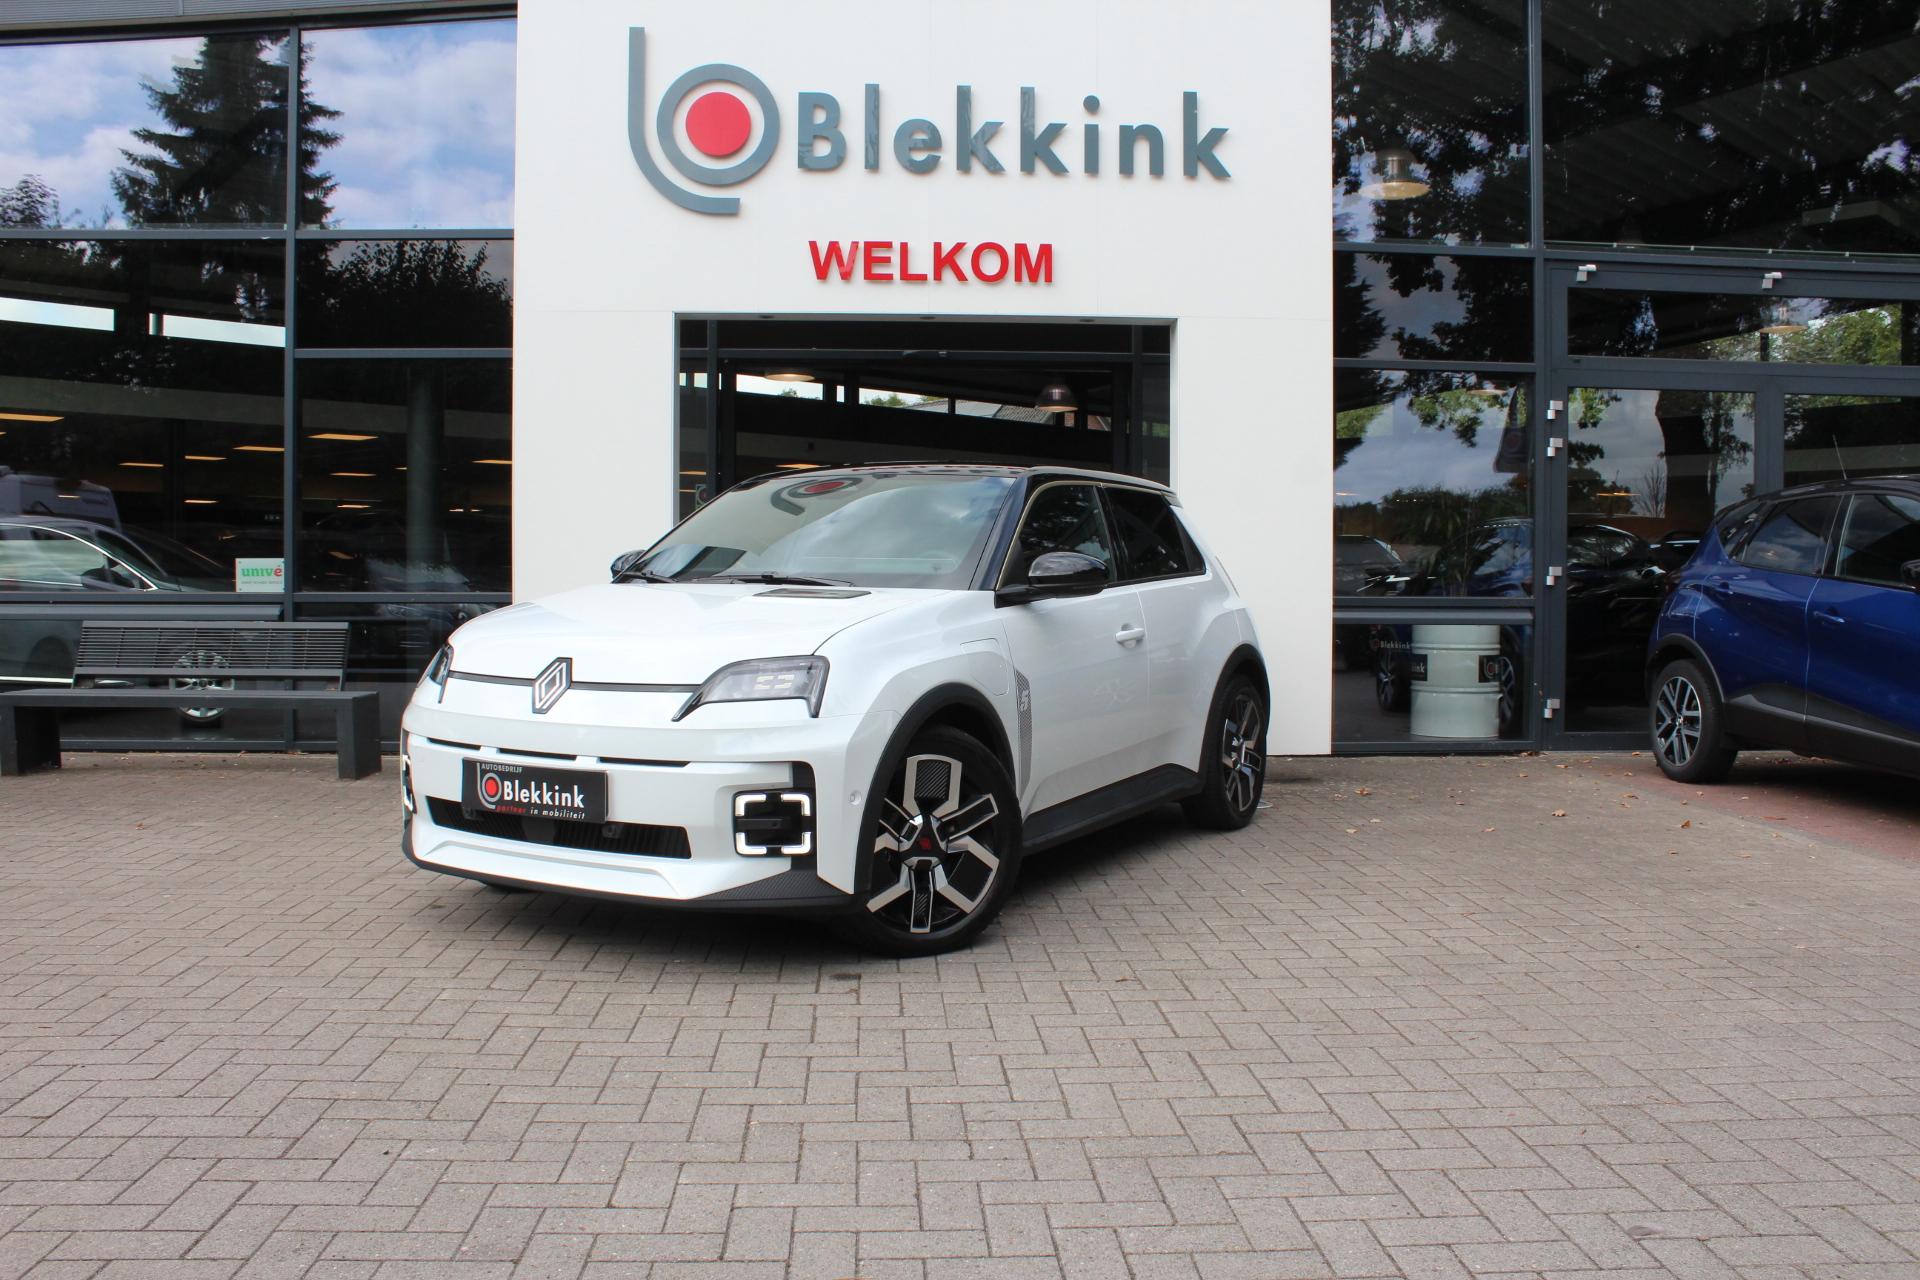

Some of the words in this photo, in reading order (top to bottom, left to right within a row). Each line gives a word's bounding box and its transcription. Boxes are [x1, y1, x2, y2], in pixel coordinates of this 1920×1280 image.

[797, 83, 1231, 179] Blekkink
[808, 240, 1054, 283] WELKOM
[481, 764, 523, 773] AUTOBEDRIJF
[503, 780, 585, 808] Blekkink
[530, 806, 539, 815] in
[542, 809, 585, 819] mobiliteit
